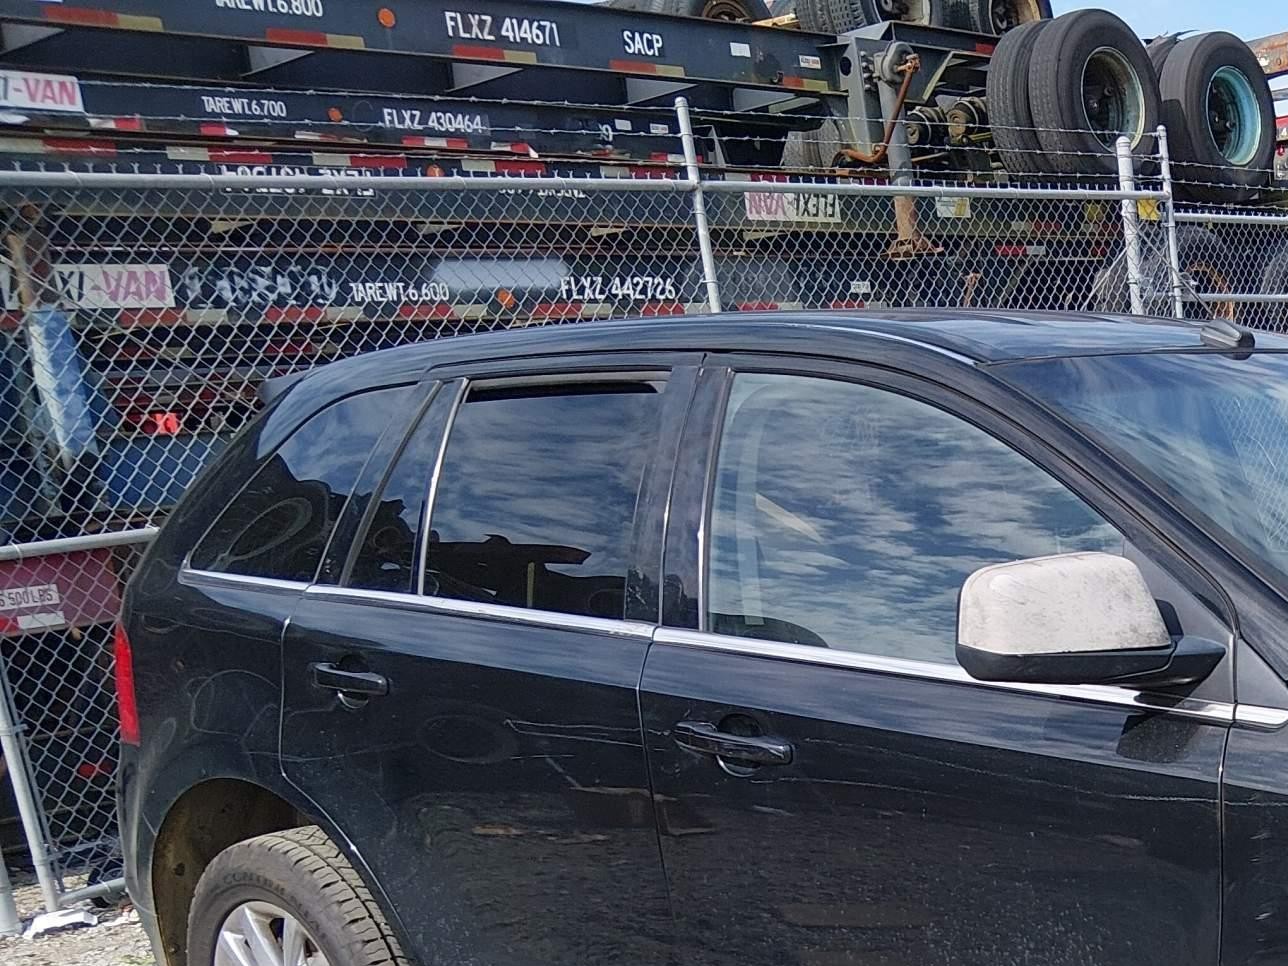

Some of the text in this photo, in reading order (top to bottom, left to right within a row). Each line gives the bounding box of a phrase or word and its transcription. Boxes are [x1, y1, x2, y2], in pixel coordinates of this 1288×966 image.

[444, 11, 561, 47] FLXZ 414671
[623, 30, 663, 57] SACP
[0, 76, 77, 106] I-VAN
[382, 108, 483, 133] FLXZ 430464
[560, 276, 677, 300] FLXZ 442726
